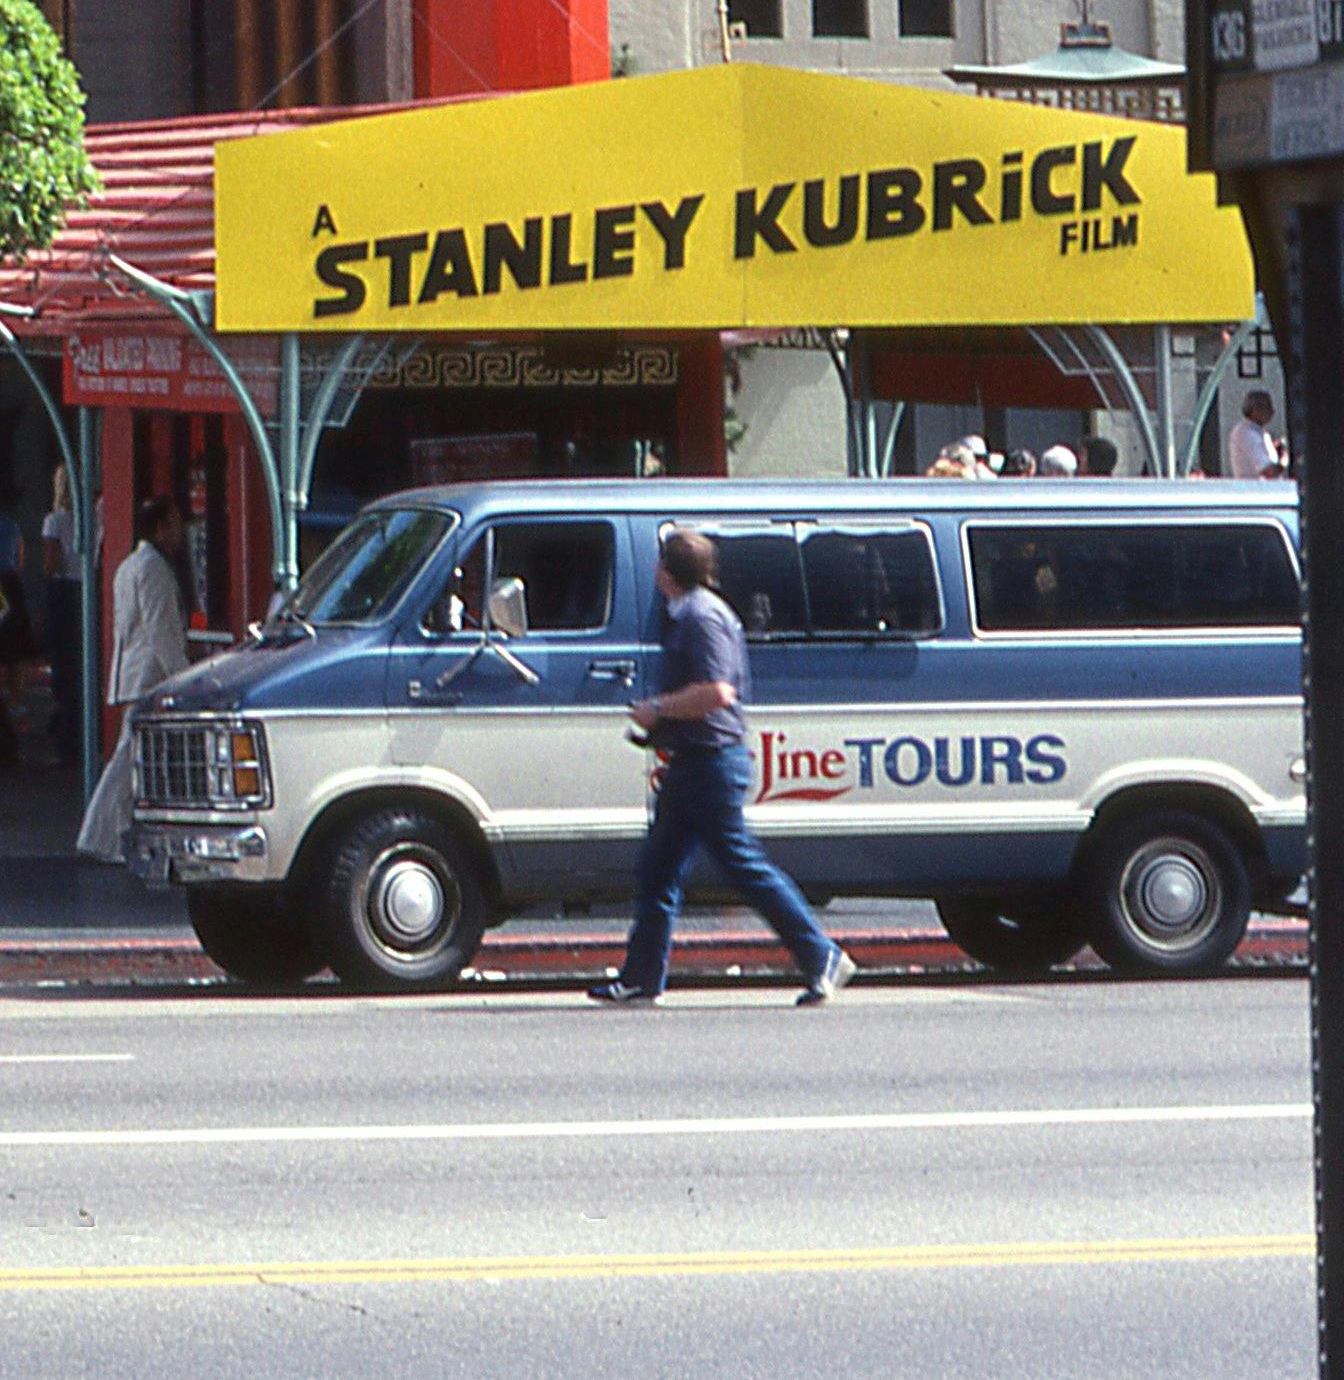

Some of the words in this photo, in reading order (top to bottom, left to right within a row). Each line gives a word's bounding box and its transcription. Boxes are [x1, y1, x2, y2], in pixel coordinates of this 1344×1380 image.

[312, 203, 337, 237] A
[1059, 212, 1139, 255] FILM
[313, 195, 705, 318] STANLEY
[844, 734, 1068, 788] TOURS
